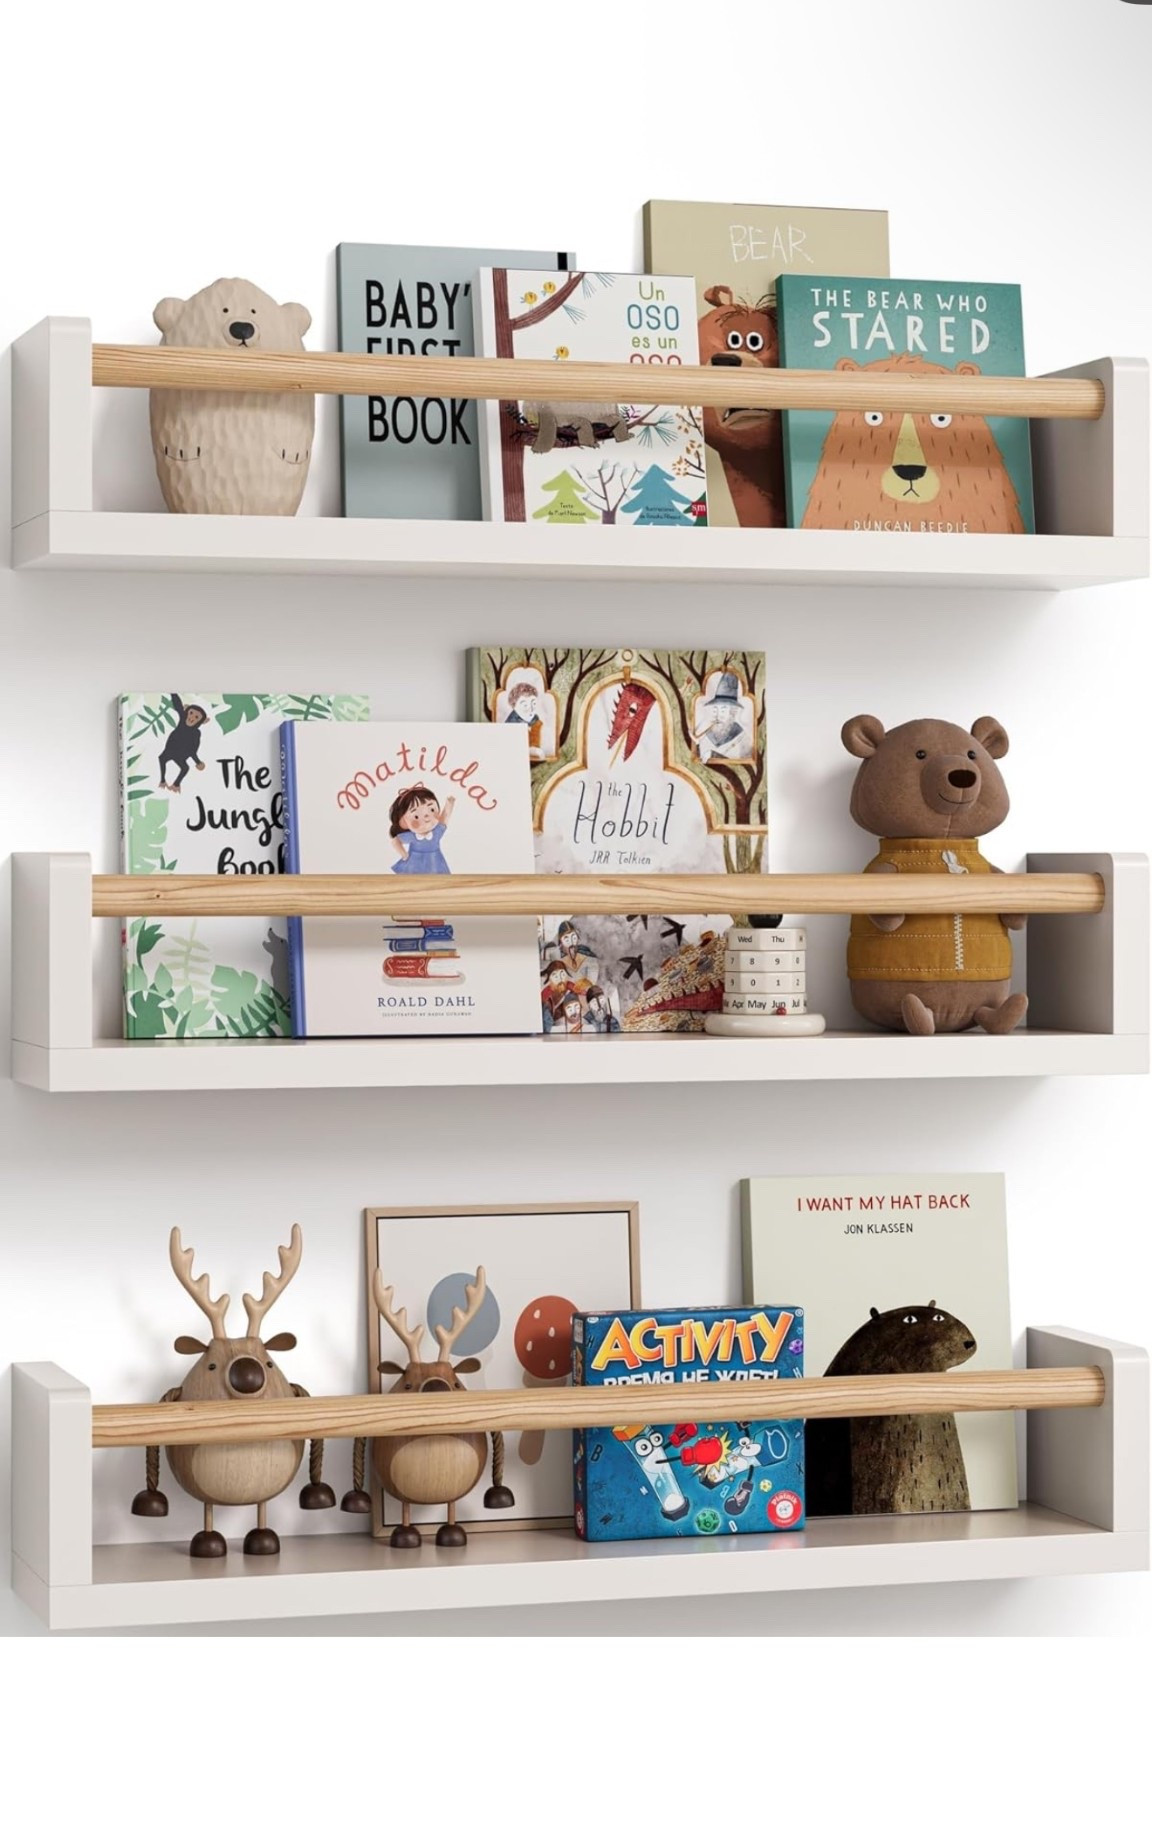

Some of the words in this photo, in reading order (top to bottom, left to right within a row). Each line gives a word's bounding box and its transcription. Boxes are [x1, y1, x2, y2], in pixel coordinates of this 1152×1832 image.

[729, 224, 814, 264] BEAR
[639, 281, 665, 301] Un
[811, 288, 851, 307] THE
[867, 290, 924, 310] BEAR
[936, 293, 987, 313] WHO
[366, 278, 471, 330] BABY'
[632, 336, 650, 349] es
[658, 337, 677, 349] un
[812, 310, 990, 355] STARED
[368, 395, 472, 445] BOOK
[216, 755, 272, 792] The
[337, 742, 498, 811] Matilda
[608, 782, 622, 797] the
[186, 792, 284, 847] Jungl
[573, 780, 675, 845] Hobbit
[617, 851, 651, 865] Tolkien
[737, 935, 753, 943] Wed
[772, 935, 785, 943] Thu
[749, 957, 755, 966] 8
[775, 957, 781, 966] 9
[377, 997, 428, 1007] ROALD
[434, 996, 476, 1007] DAHL
[747, 1000, 767, 1010] May
[771, 1001, 787, 1009] Jun
[797, 1197, 802, 1212] I
[806, 1196, 854, 1212] WANT
[859, 1195, 886, 1210] MY
[891, 1194, 923, 1210] HAT
[928, 1193, 971, 1209] BACK
[843, 1224, 863, 1235] JON
[867, 1222, 913, 1234] KLASSEN
[590, 1311, 794, 1371] ACTIVITY
